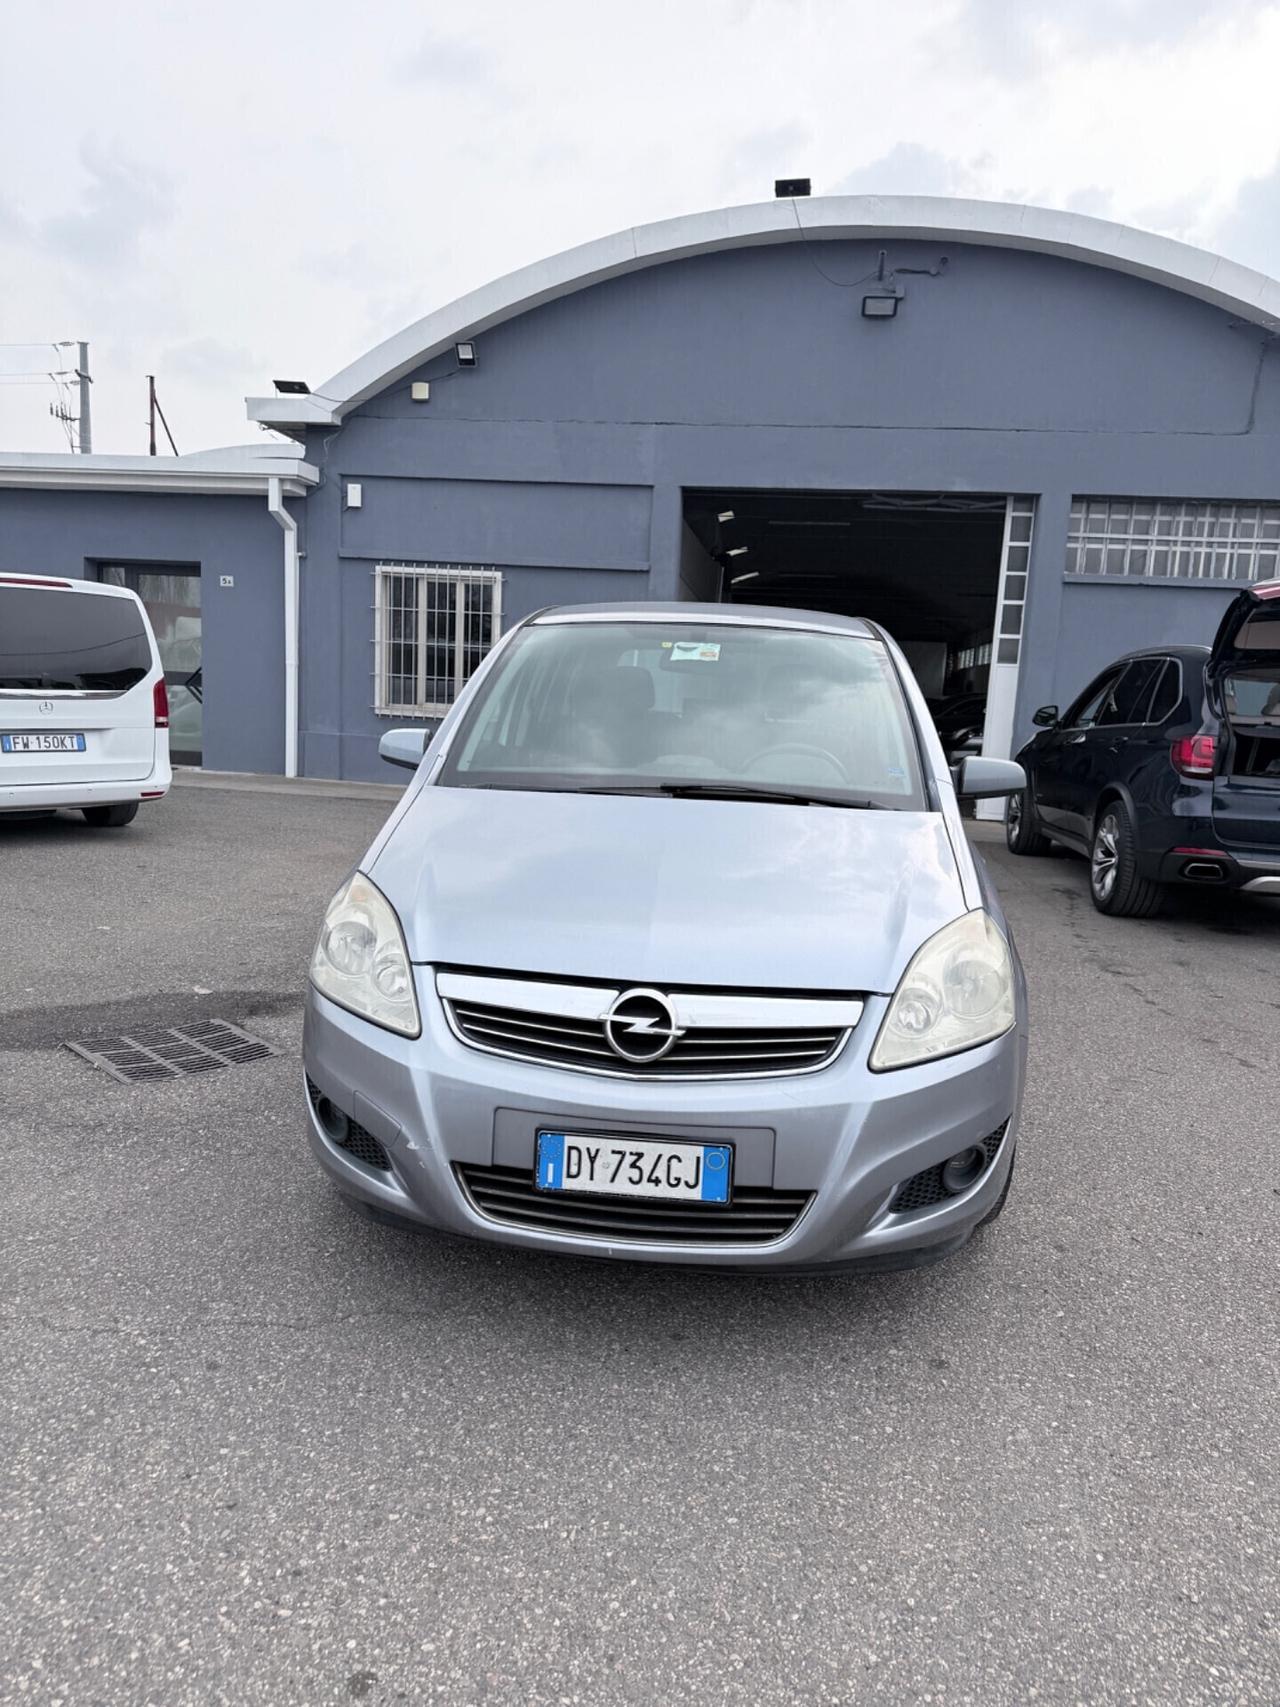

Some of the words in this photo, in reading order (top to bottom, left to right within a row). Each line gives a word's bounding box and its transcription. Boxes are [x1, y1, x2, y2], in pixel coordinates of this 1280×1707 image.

[12, 736, 30, 749] FW
[36, 736, 75, 749] 150KT
[566, 1145, 600, 1181] DY
[609, 1150, 701, 1189] 734GJ
